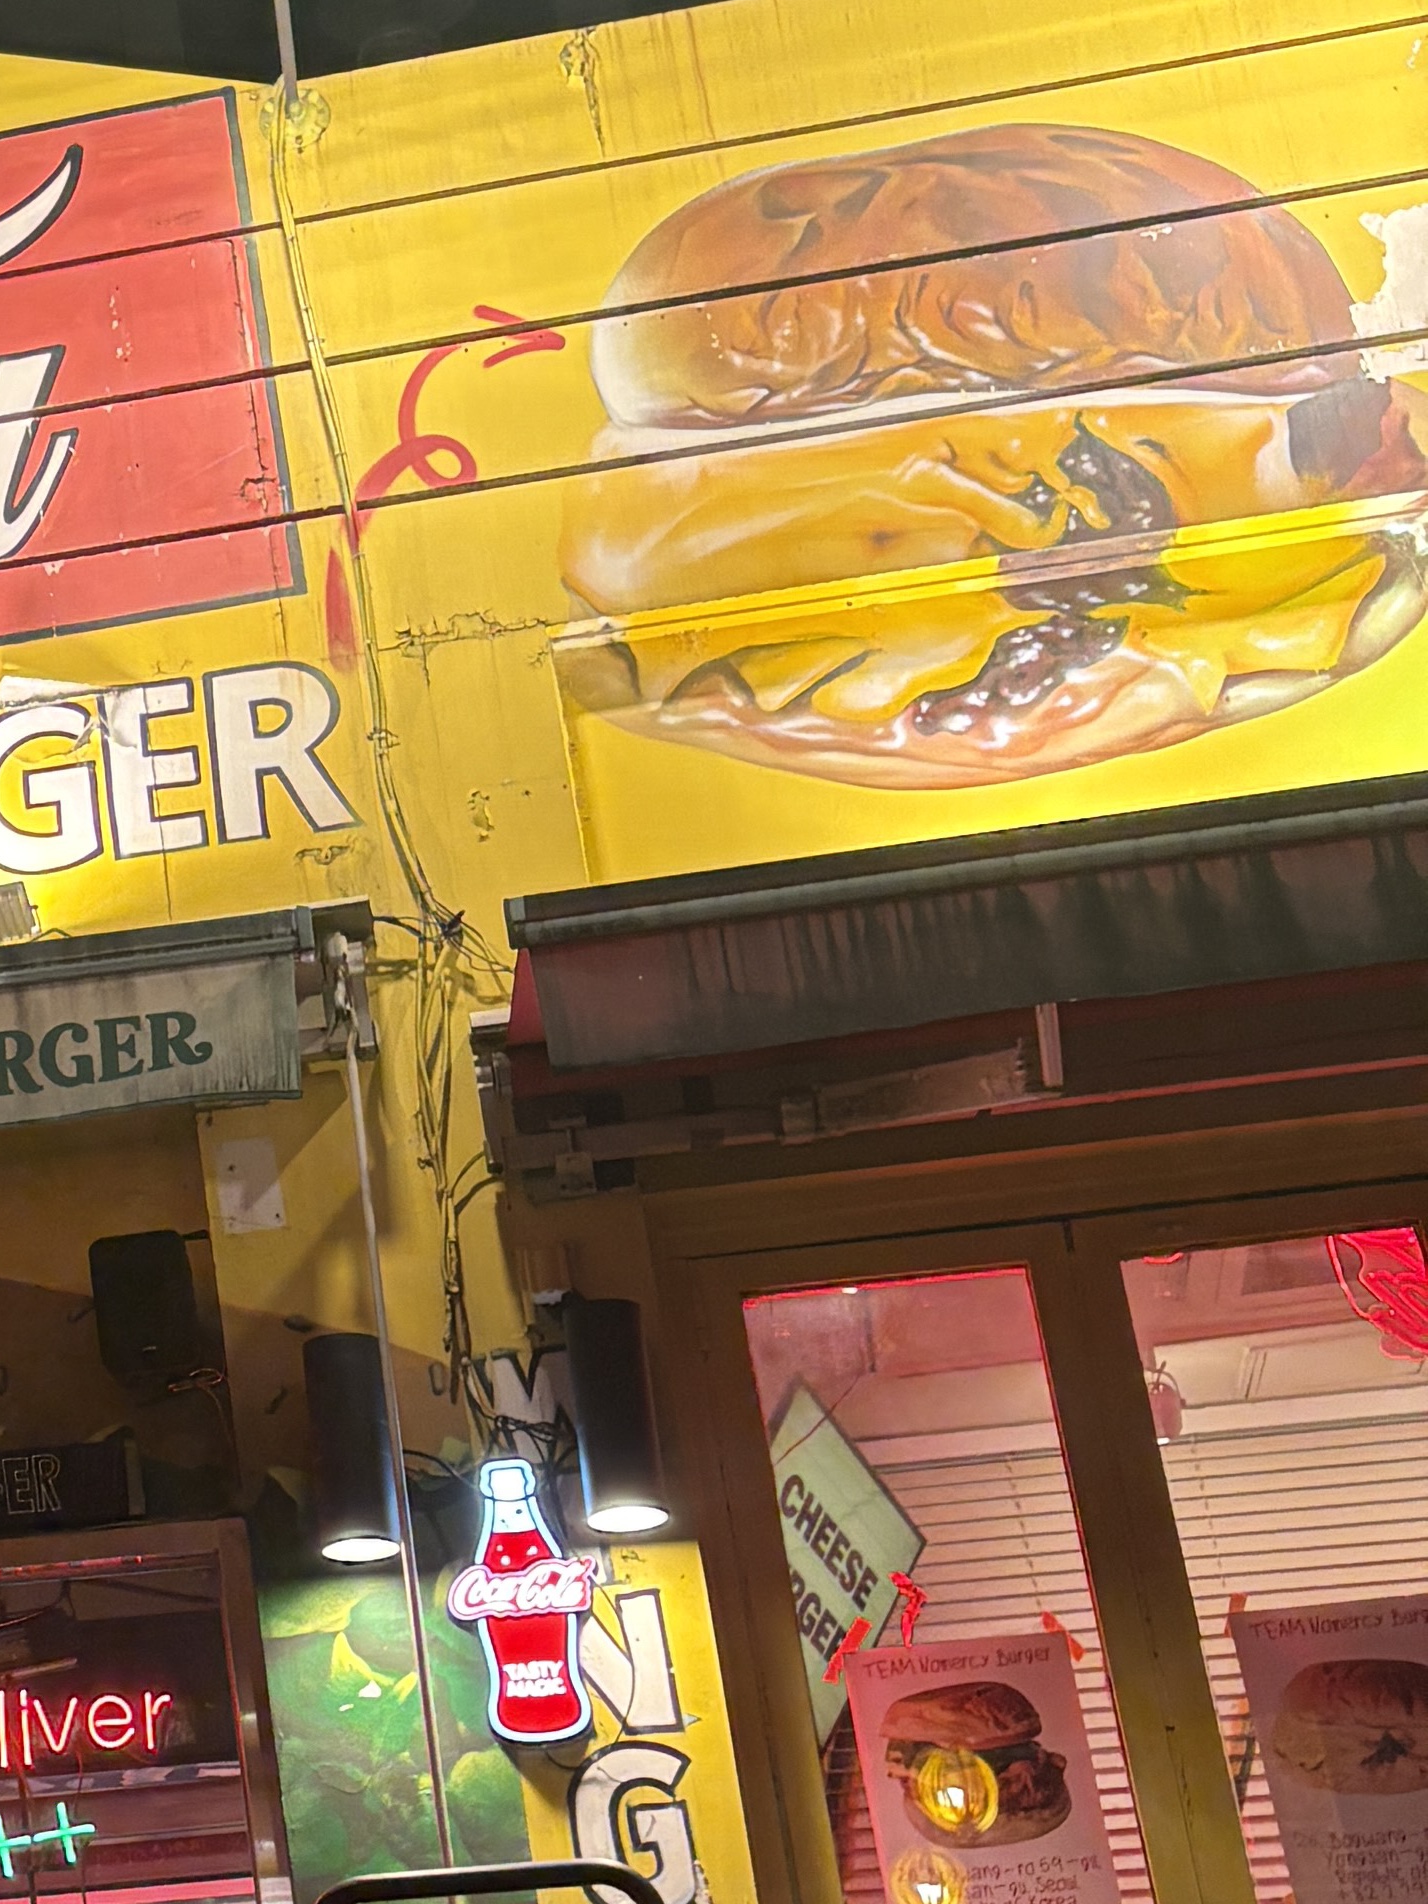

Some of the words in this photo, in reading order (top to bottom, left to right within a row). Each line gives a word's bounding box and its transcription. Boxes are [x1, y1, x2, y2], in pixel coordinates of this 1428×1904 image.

[779, 1474, 879, 1613] CHEESE
[503, 1660, 564, 1681] TASTY
[862, 1658, 915, 1681] TEAM
[996, 1646, 1051, 1668] Burger
[505, 1678, 567, 1698] MAGIC
